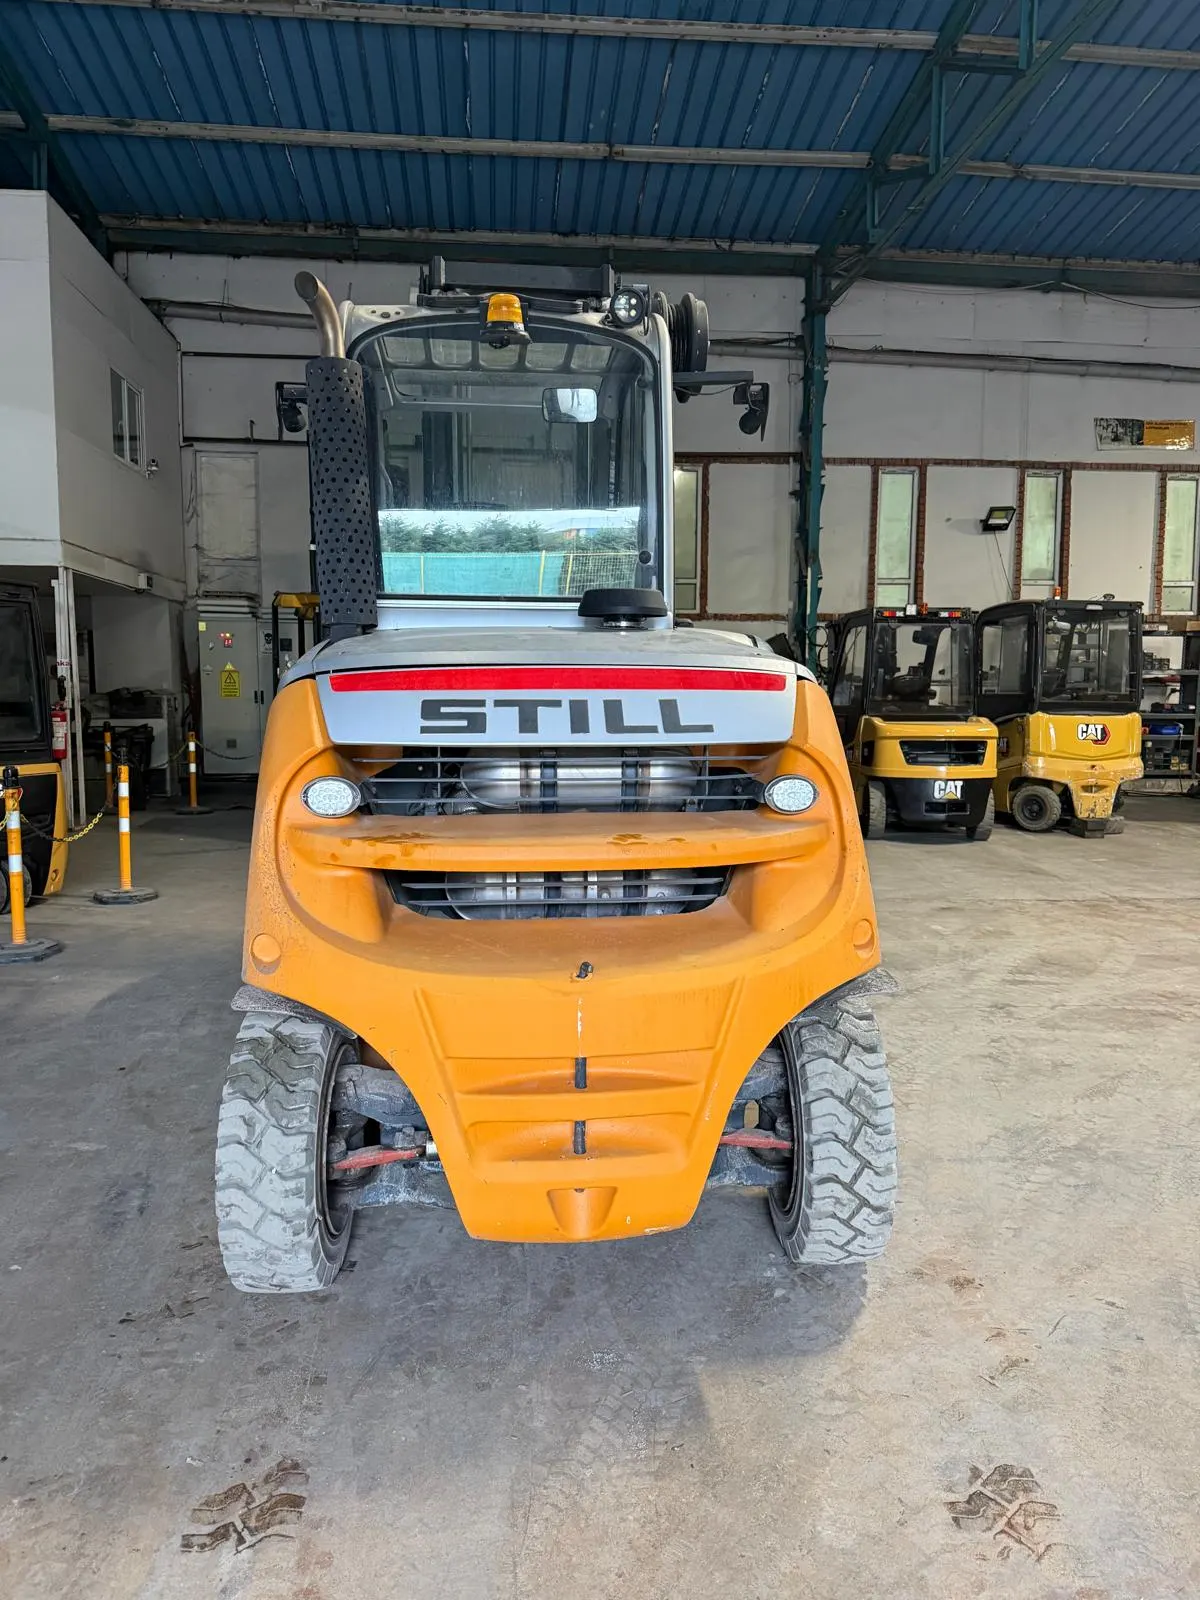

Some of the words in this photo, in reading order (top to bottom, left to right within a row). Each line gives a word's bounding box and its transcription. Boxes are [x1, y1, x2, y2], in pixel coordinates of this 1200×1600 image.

[420, 699, 714, 734] STILL
[1078, 724, 1104, 740] CAT
[934, 780, 963, 799] CAT
